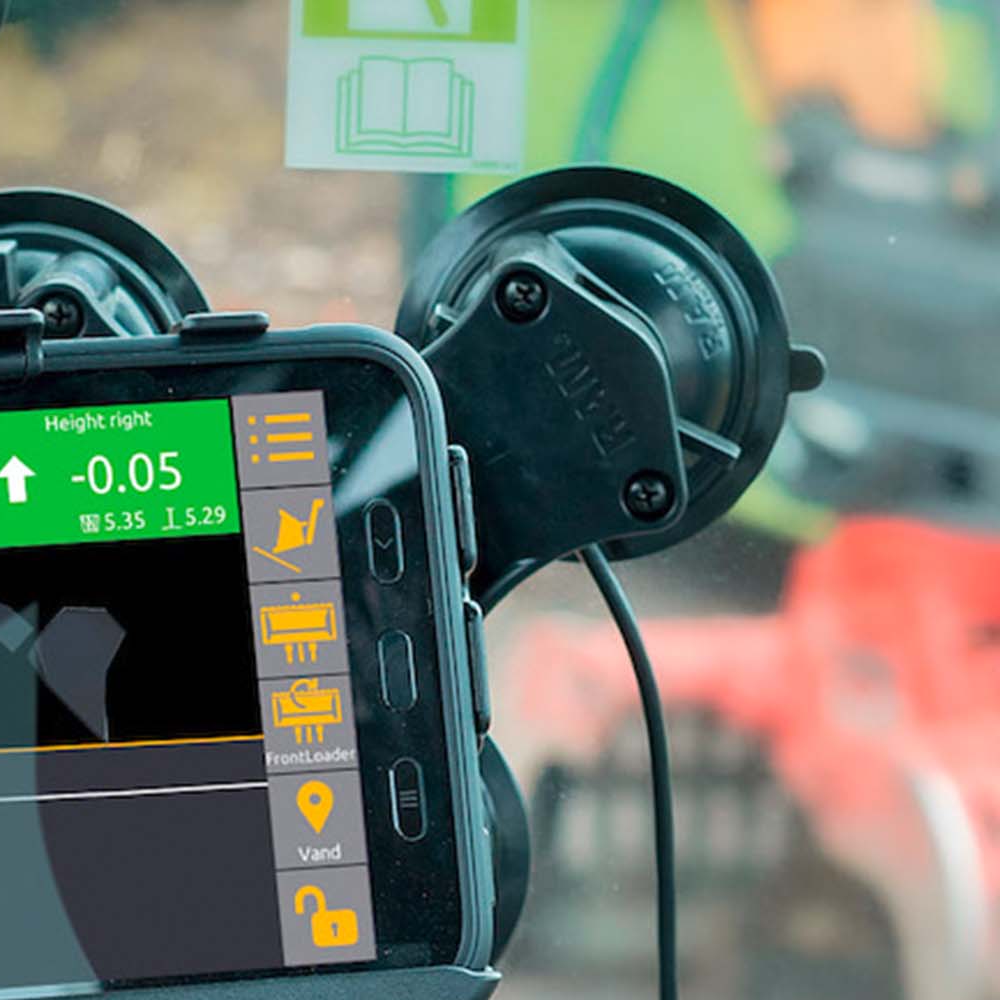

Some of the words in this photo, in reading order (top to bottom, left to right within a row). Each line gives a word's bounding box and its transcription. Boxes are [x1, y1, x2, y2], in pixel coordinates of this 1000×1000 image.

[44, 413, 106, 434] Height
[109, 411, 153, 431] right
[71, 451, 182, 496] -0.05
[104, 511, 146, 531] 5.35
[185, 506, 227, 526] 5.29
[266, 748, 355, 766] FrontLoader
[298, 844, 341, 862] Vand
